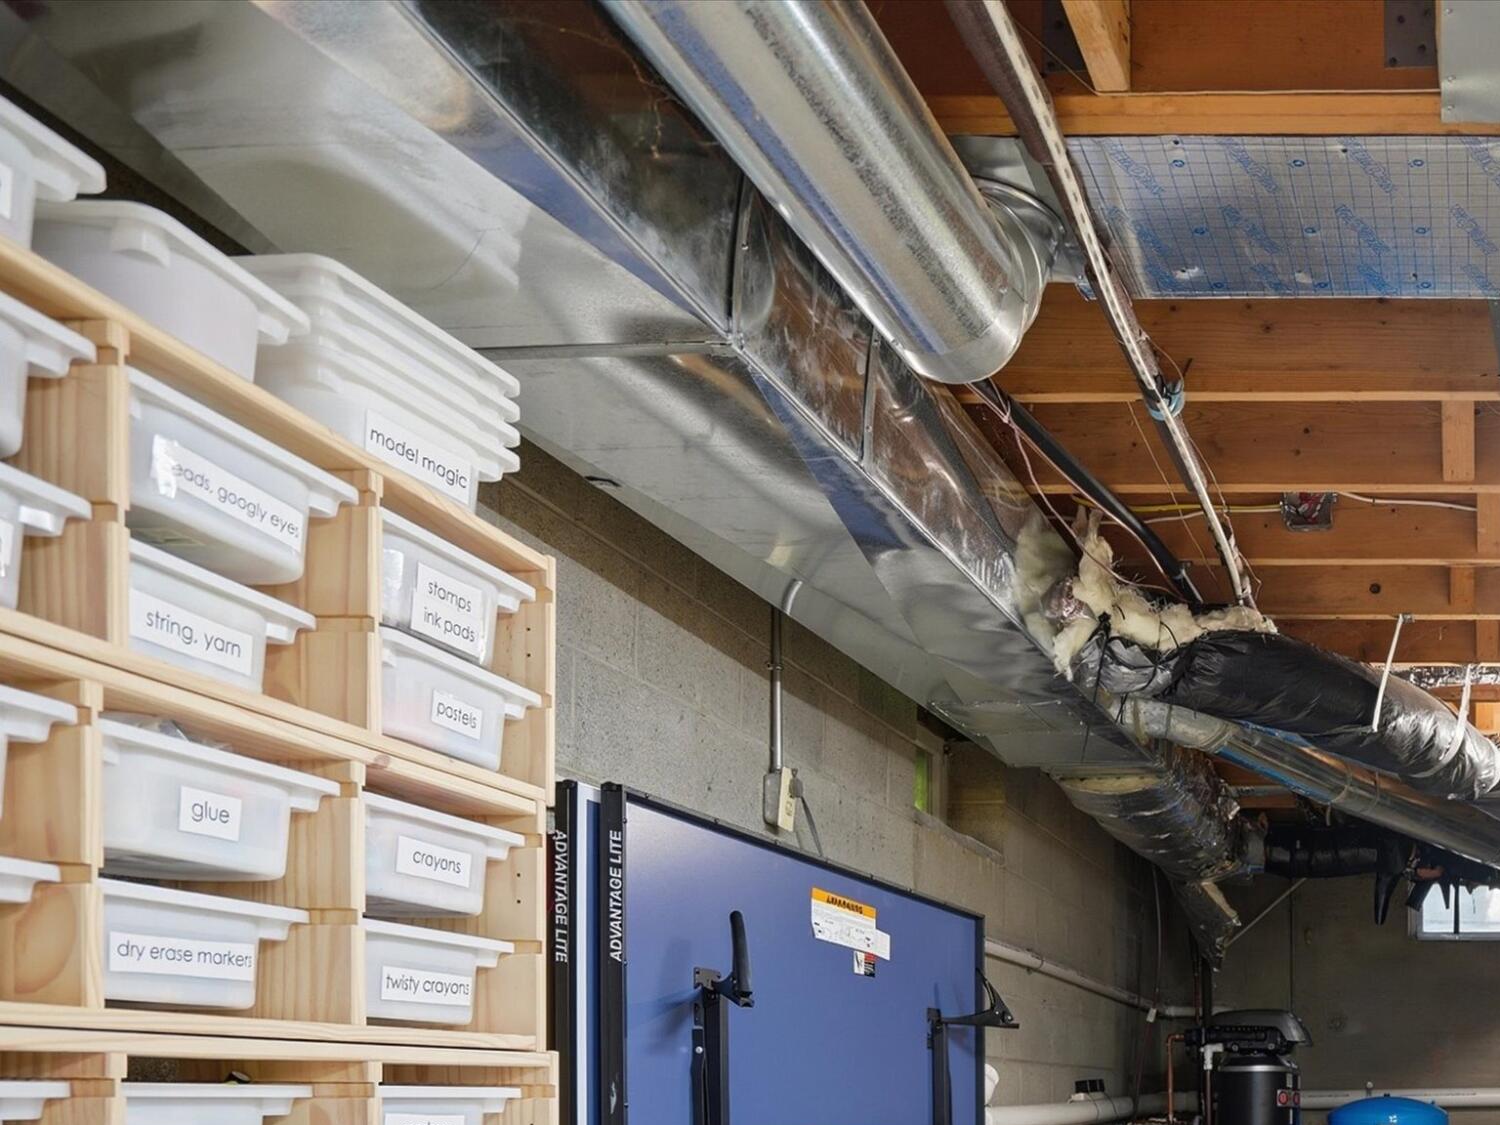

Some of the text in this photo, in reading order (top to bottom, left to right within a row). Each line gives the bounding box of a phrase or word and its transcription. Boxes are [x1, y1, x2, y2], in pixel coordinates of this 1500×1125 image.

[370, 429, 467, 489] model magic
[171, 463, 214, 494] eads,
[217, 486, 268, 522] googly
[427, 581, 472, 612] stamps
[146, 610, 241, 658] string, yarn
[423, 606, 476, 643] ink pads
[436, 701, 478, 730] pastels
[191, 801, 230, 824] glue
[412, 851, 462, 874] crayons
[552, 829, 568, 962] ADVANTAGE LITE
[609, 830, 622, 962] ADVANTAGE LITE
[117, 940, 146, 961] dry
[150, 946, 193, 963] erase
[386, 974, 420, 995] twisty
